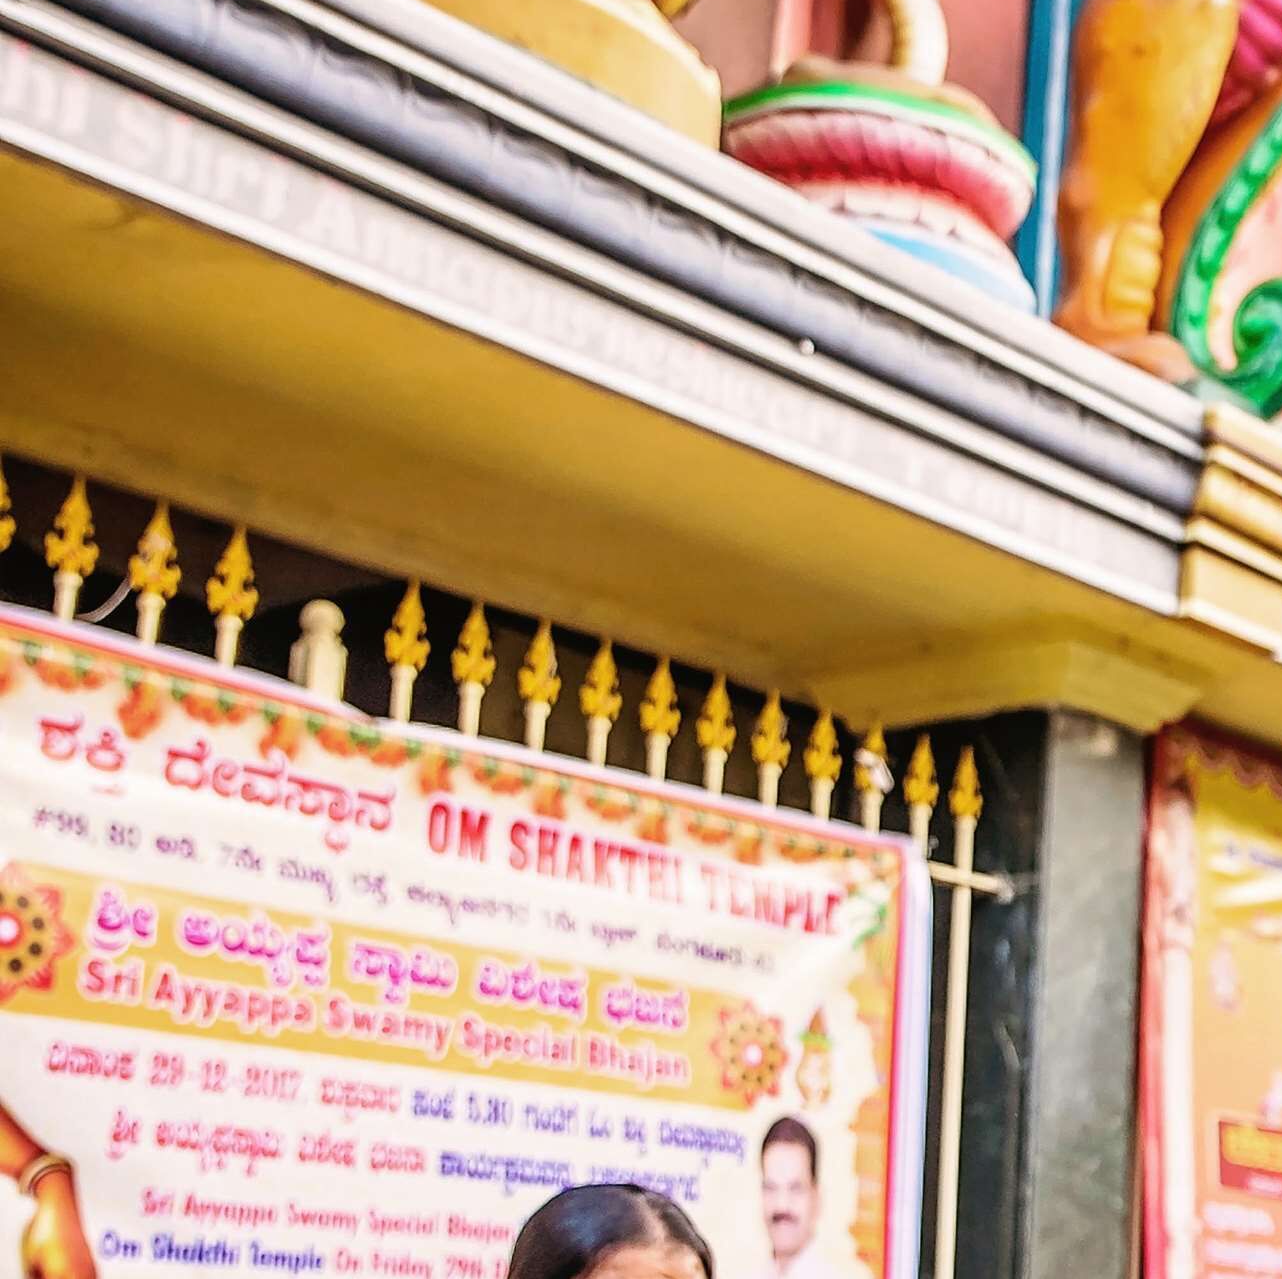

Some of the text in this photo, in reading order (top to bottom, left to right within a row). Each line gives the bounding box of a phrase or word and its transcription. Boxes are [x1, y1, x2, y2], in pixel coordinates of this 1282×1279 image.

[164, 738, 396, 852] ದೇವಸ್ಥಾನ
[94, 889, 154, 951] ಶ್ರೀ
[428, 801, 492, 863] OM
[509, 820, 684, 907] SHAKTHI
[702, 865, 844, 935] TEMPLE
[86, 959, 689, 1083] Sri Ayyappa Swamy Special Bhajan
[102, 1229, 140, 1260] Om
[249, 1239, 325, 1276] Temple
